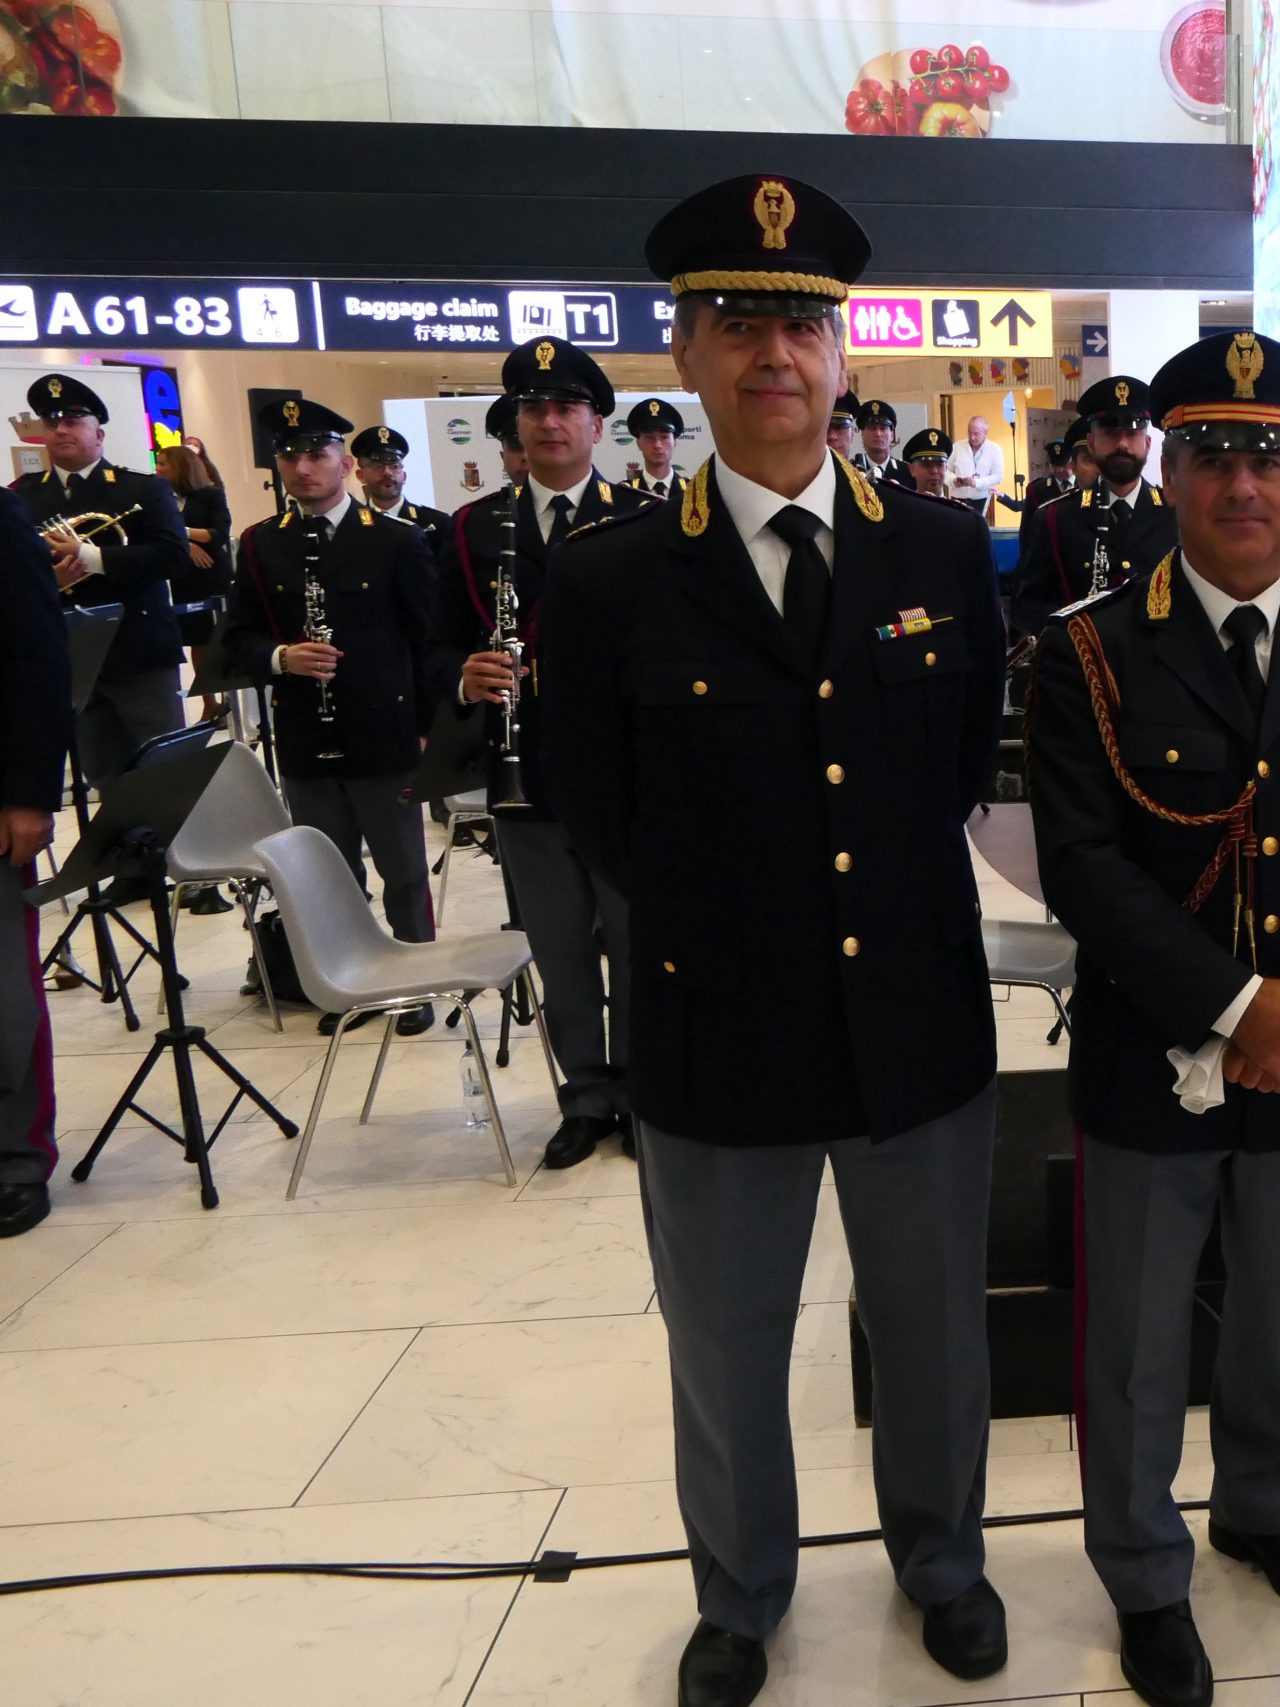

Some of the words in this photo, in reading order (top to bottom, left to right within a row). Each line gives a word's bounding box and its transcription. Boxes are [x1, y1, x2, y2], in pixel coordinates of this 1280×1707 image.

[345, 297, 438, 320] Baggage
[441, 298, 499, 318] claim
[654, 301, 677, 319] Ex
[566, 303, 611, 335] T1
[414, 323, 500, 342] 行李提取处
[936, 336, 978, 348] Shopping
[682, 425, 702, 434] porti
